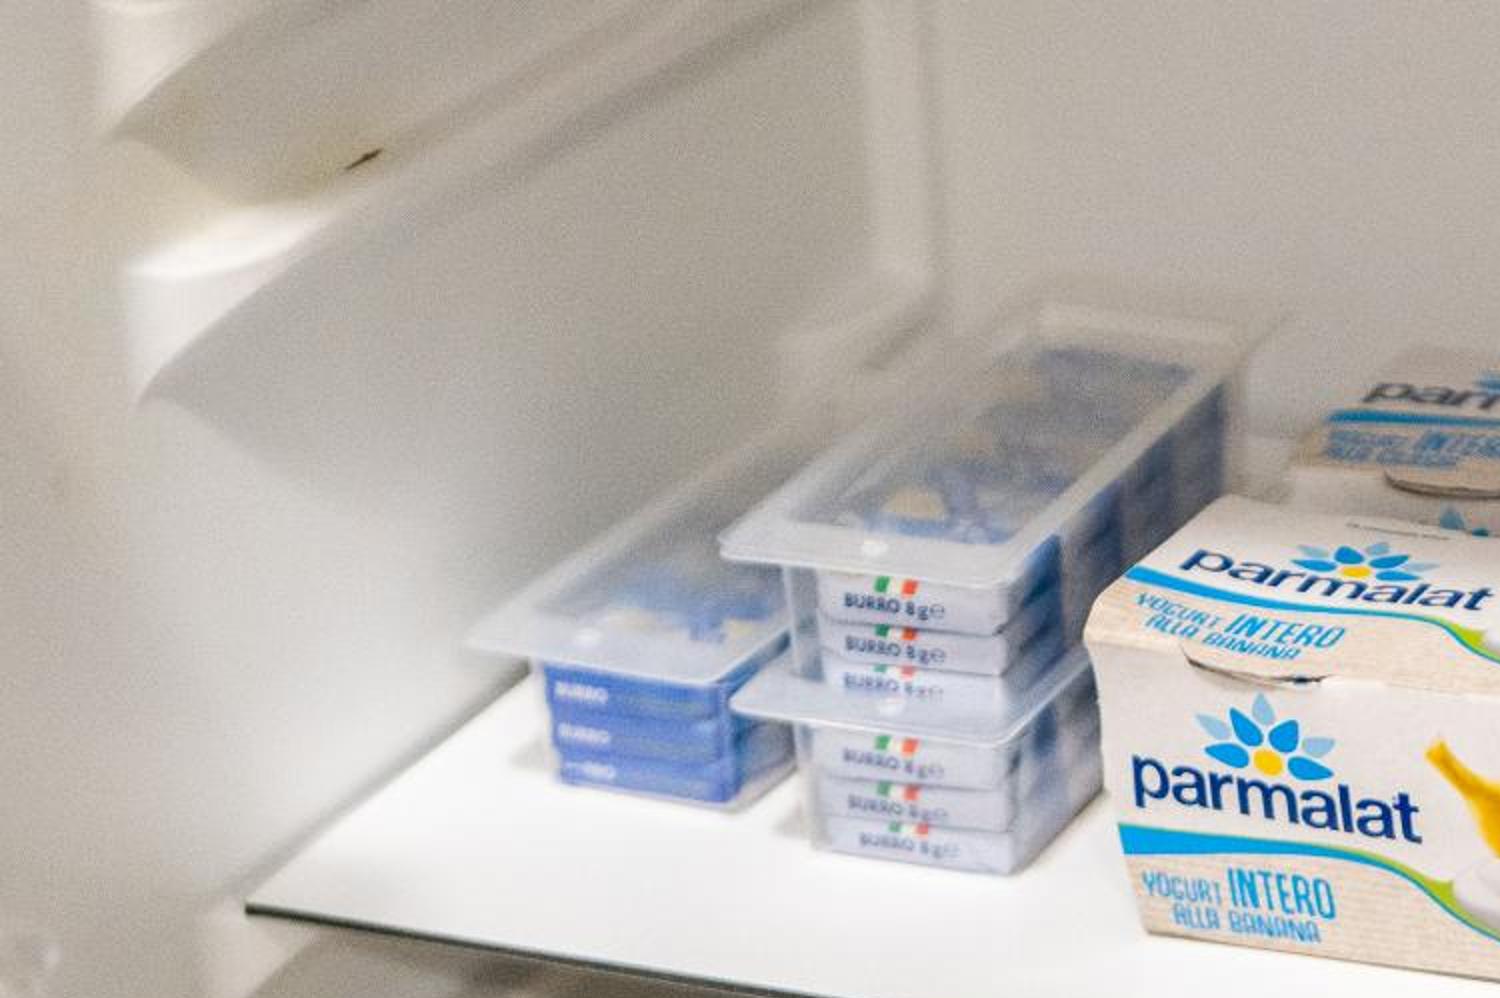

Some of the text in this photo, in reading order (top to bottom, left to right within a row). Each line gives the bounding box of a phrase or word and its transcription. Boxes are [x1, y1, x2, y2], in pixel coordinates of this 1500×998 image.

[1179, 549, 1495, 611] parmalat
[844, 591, 900, 614] BURRO
[1135, 592, 1346, 649] YOGURT INTERO
[845, 635, 902, 657] BURRO
[1145, 614, 1301, 661] ALLA BANANA
[842, 748, 899, 769] BURRO
[847, 793, 903, 816] BURRO
[1131, 753, 1423, 844] parmalat
[1141, 867, 1337, 919] YOGURT INTERO
[1173, 903, 1322, 944] ALLA BANANA
